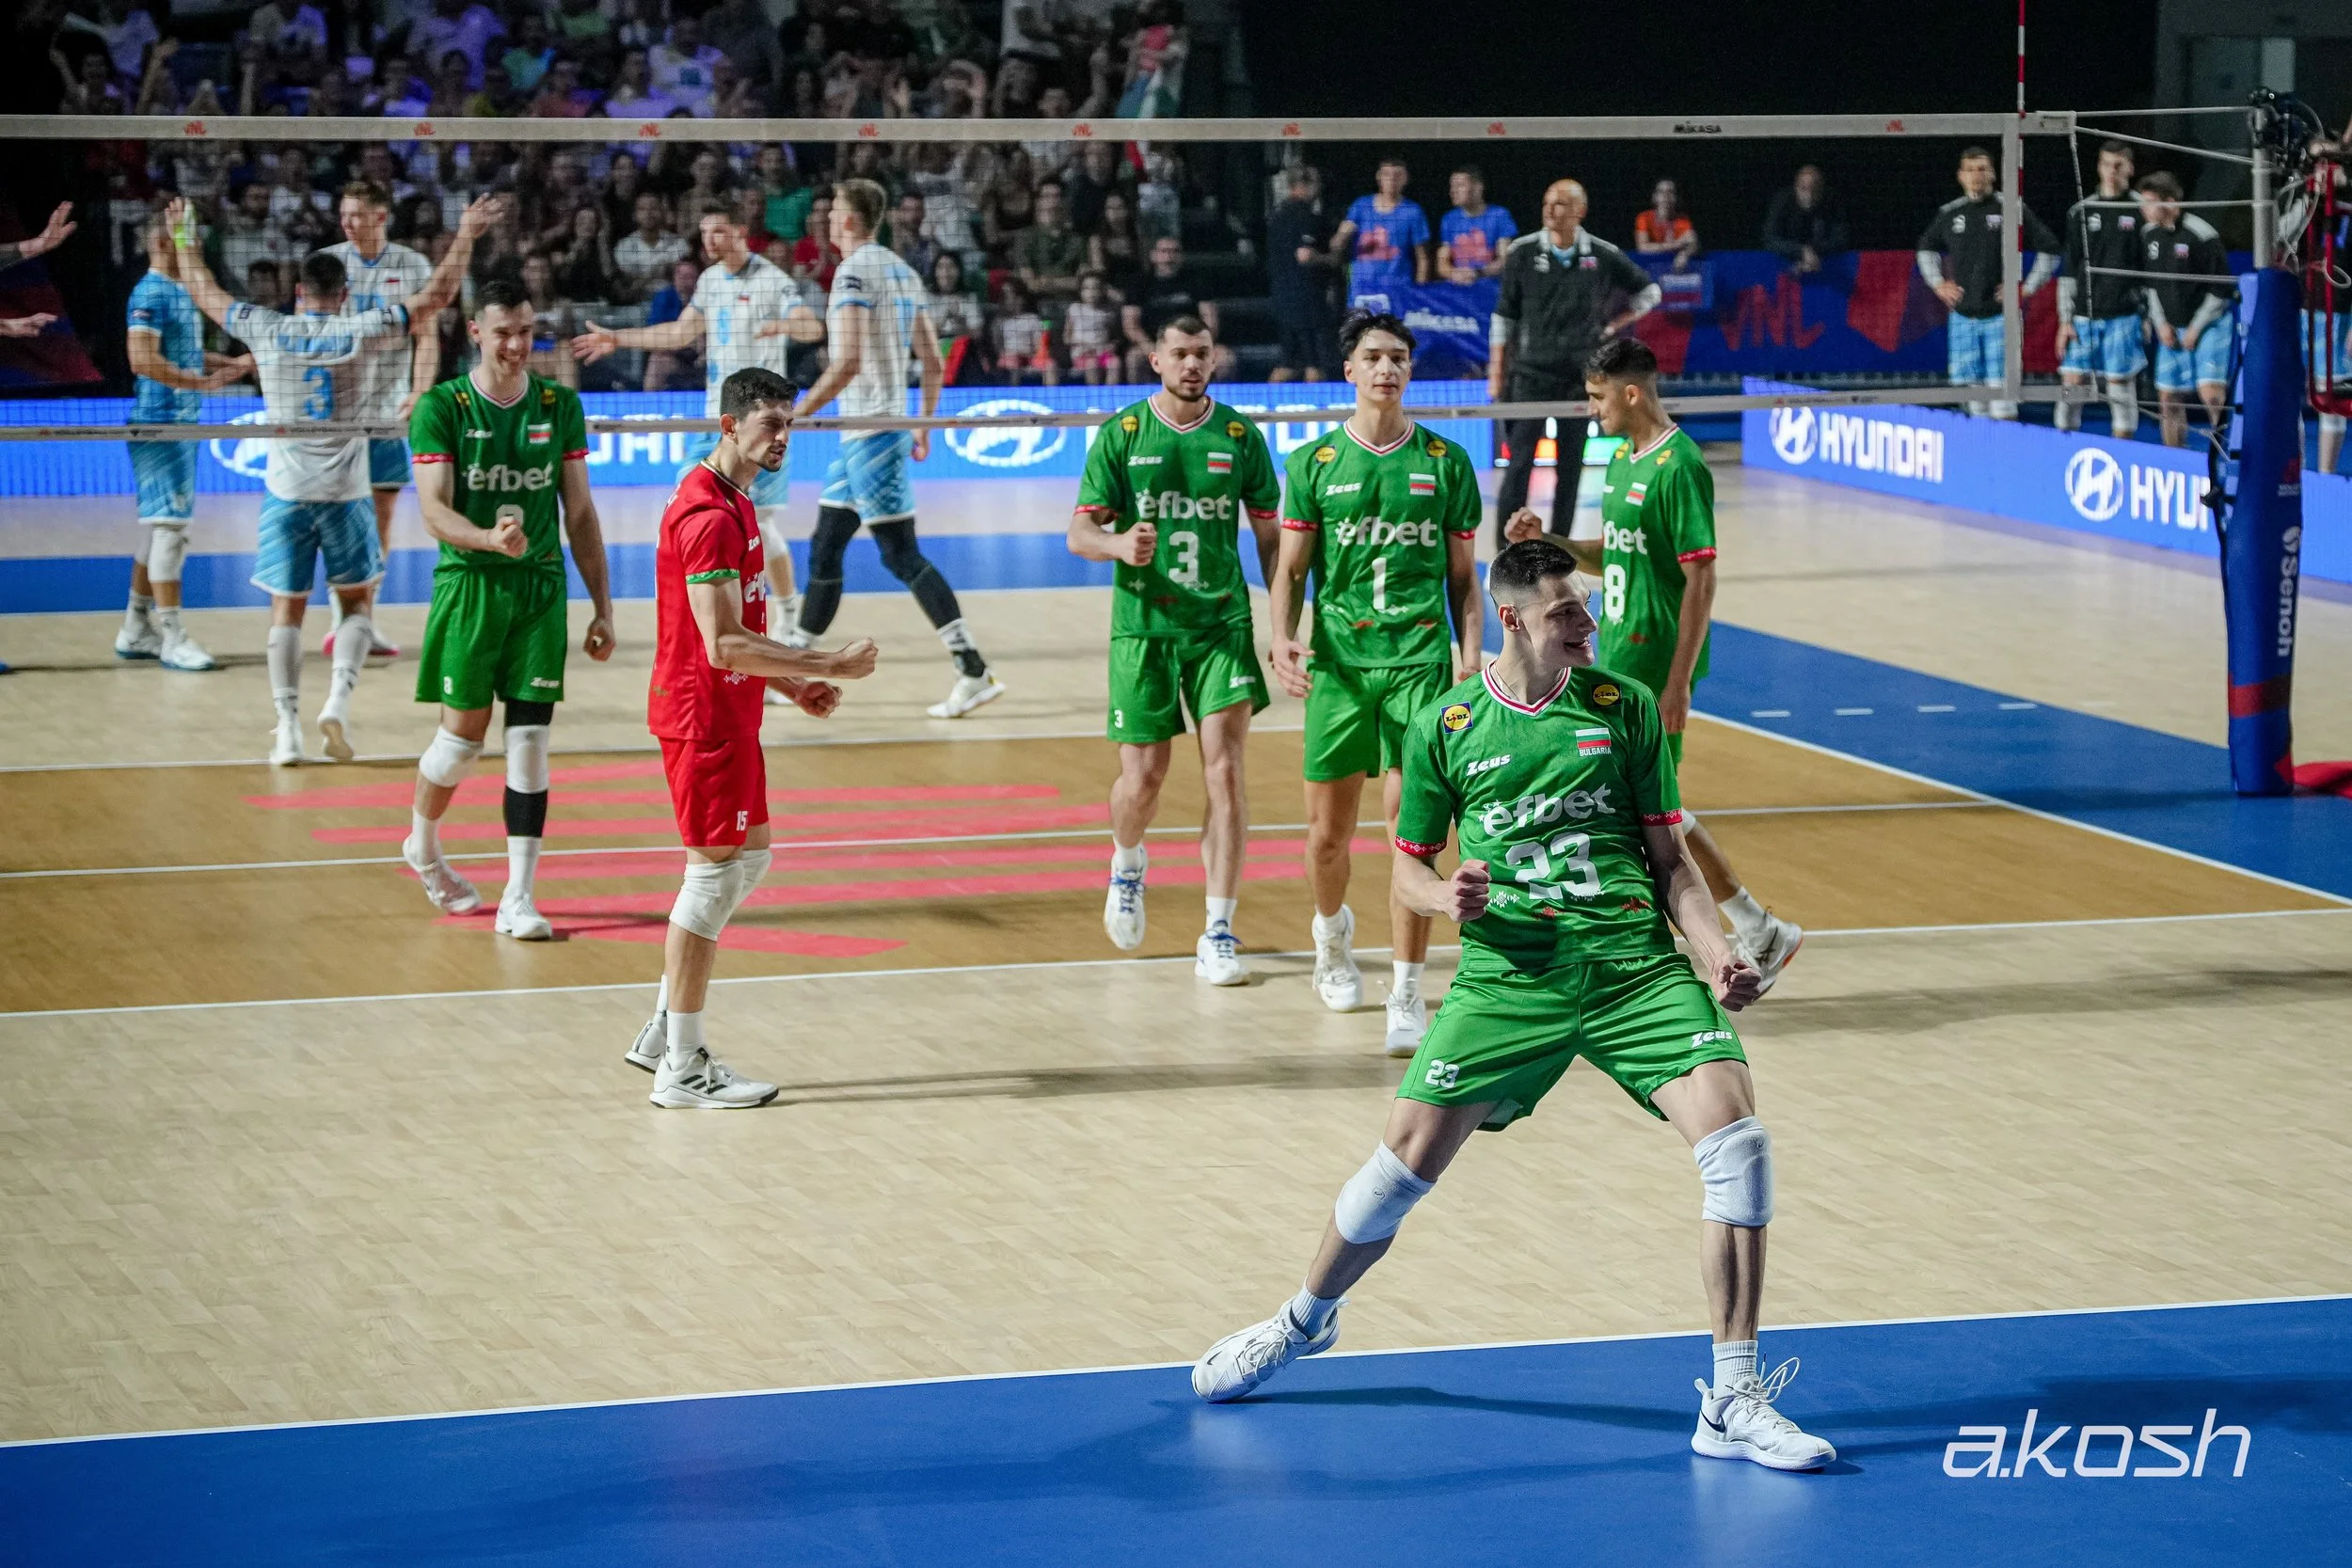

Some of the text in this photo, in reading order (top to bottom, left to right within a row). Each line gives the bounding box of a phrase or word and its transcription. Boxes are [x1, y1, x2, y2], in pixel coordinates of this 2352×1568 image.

[303, 366, 333, 421] 3
[1819, 411, 1945, 483] HYUNDAI
[1136, 489, 1232, 520] efbet
[1335, 515, 1438, 547] efbet
[1168, 531, 1200, 583] 3
[1371, 557, 1388, 610] 1
[1603, 563, 1627, 621] 8
[2277, 555, 2298, 657] Senoh
[1114, 709, 1124, 728] 3
[1466, 753, 1511, 777] Zeus
[1579, 747, 1612, 756] BULGARIA
[736, 810, 749, 832] 15
[1482, 783, 1616, 837] efbet
[1505, 832, 1602, 900] 23
[1692, 1029, 1733, 1049] Zeus
[1424, 1059, 1460, 1089] 23
